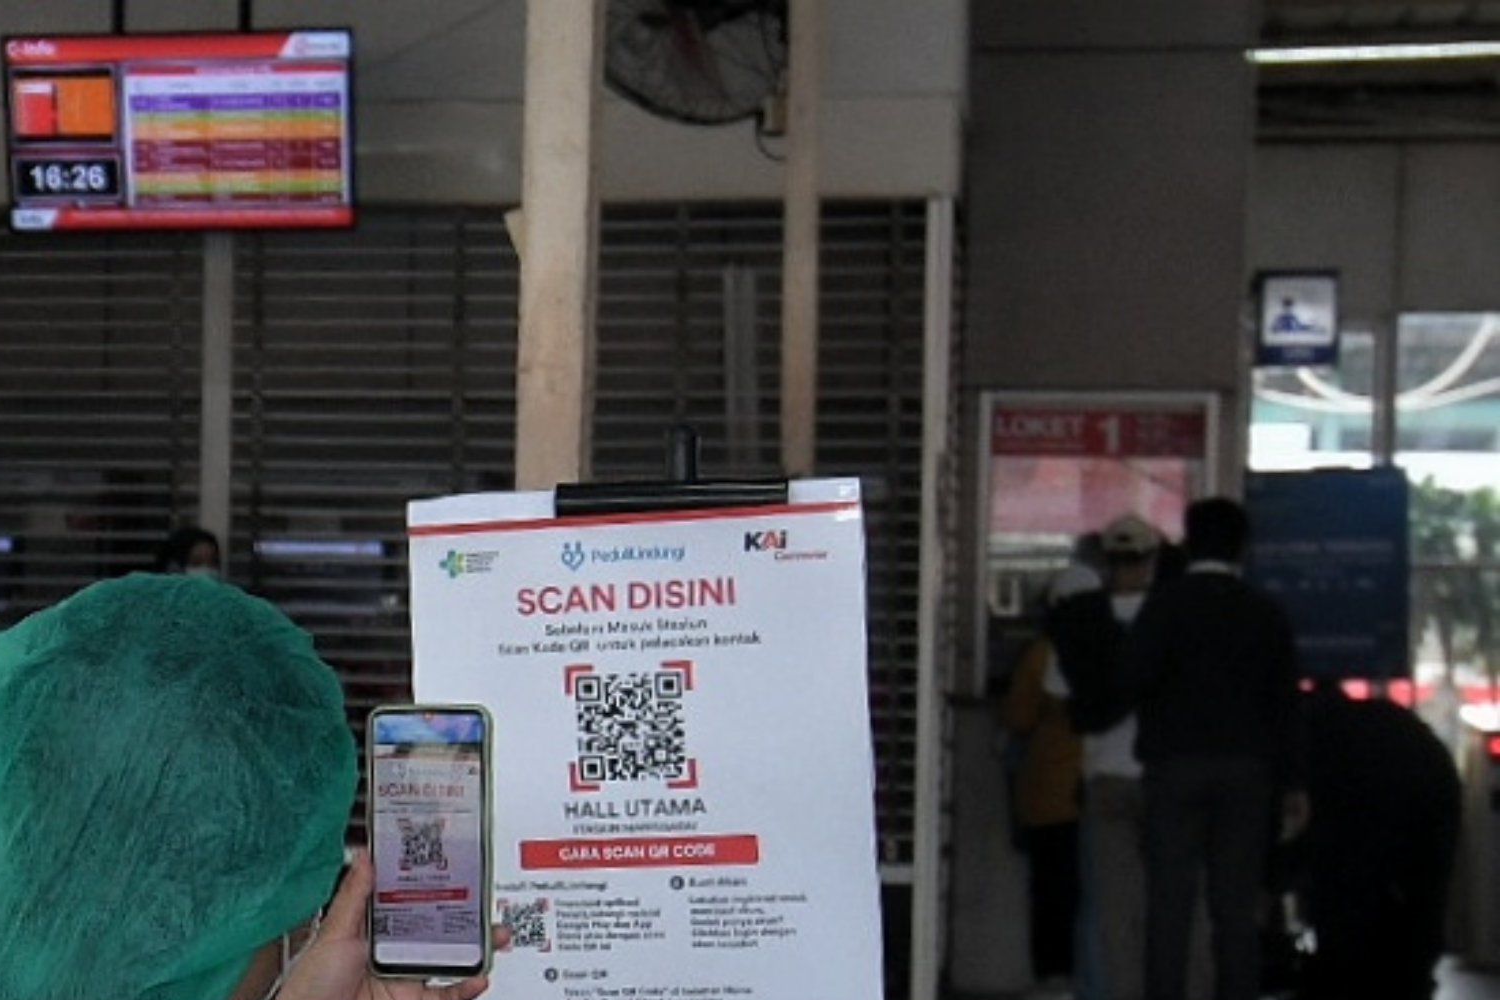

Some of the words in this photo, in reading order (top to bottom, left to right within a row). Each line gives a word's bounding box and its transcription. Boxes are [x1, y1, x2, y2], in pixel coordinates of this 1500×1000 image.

[30, 164, 106, 191] 16:26
[995, 413, 1084, 438] LOKET
[1098, 414, 1121, 453] 1
[516, 583, 617, 616] SCAN
[628, 576, 736, 609] DISINI
[564, 801, 620, 820] HALL
[625, 798, 708, 817] UTAMA
[558, 847, 600, 861] CARA
[604, 846, 645, 860] SCAN
[673, 843, 716, 857] CODE
